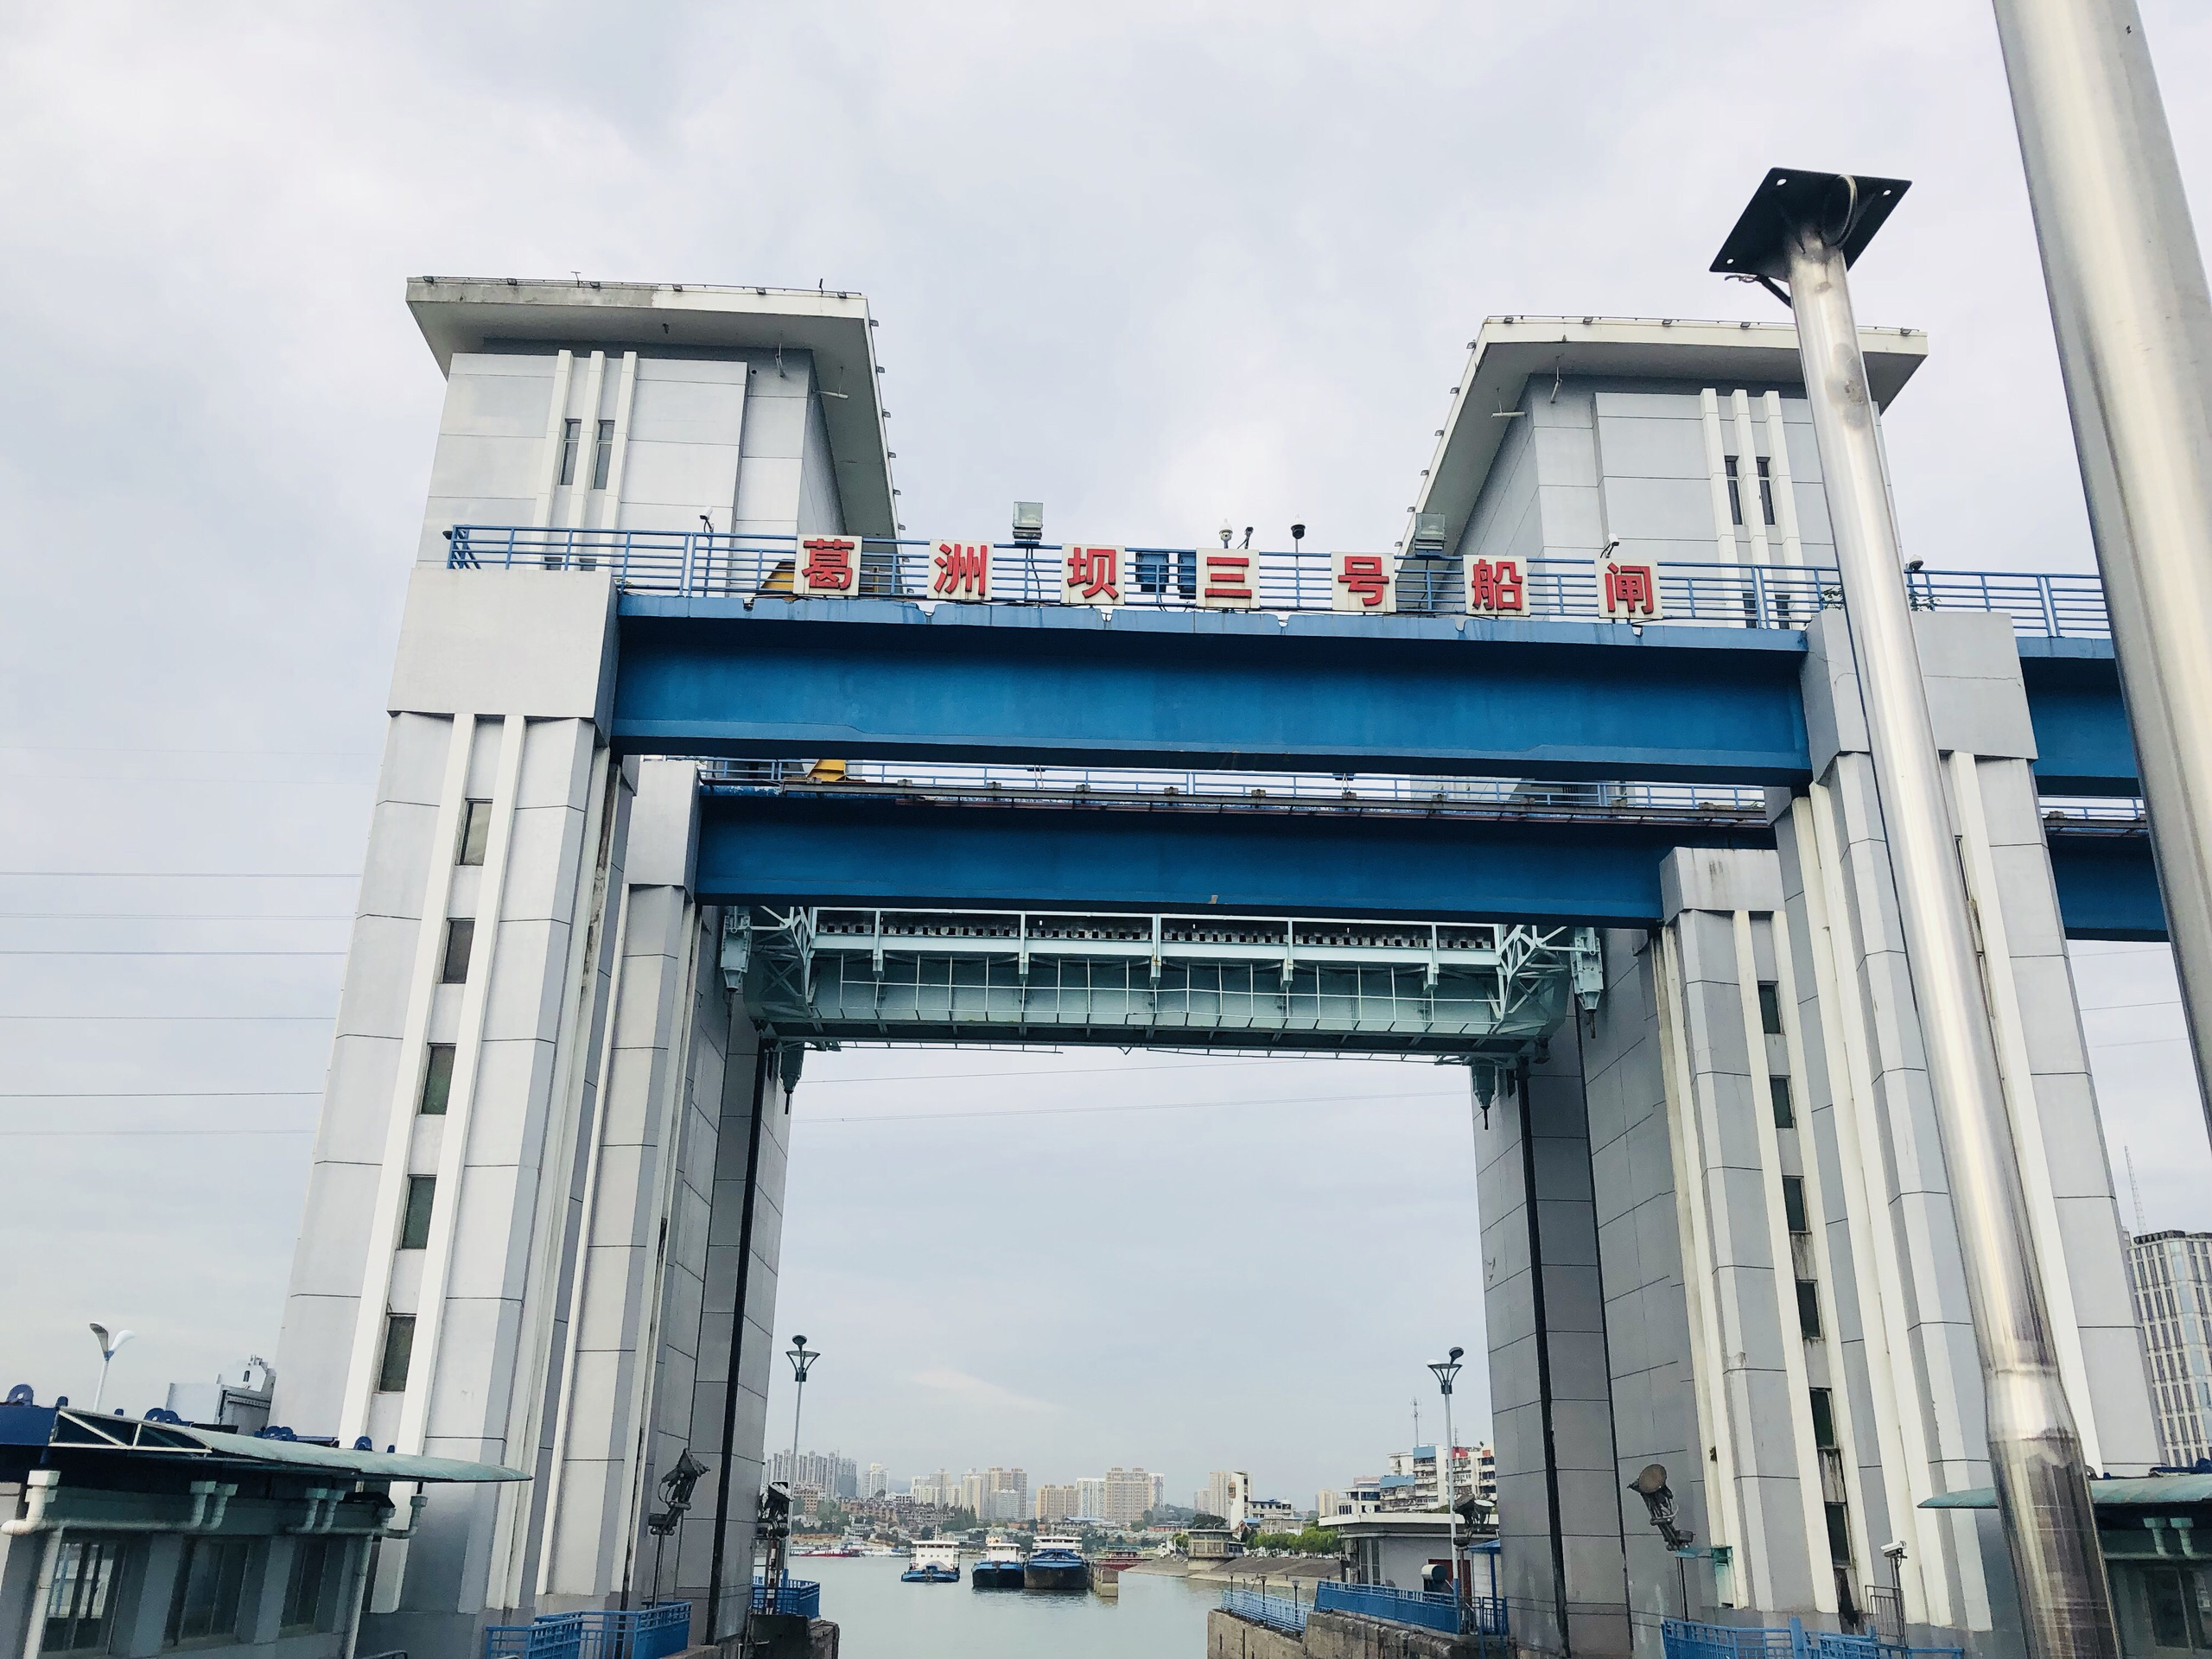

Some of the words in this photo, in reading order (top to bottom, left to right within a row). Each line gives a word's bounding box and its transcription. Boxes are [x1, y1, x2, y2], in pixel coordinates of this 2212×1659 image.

[802, 538, 1654, 613] 葛洲坝三号船闸
